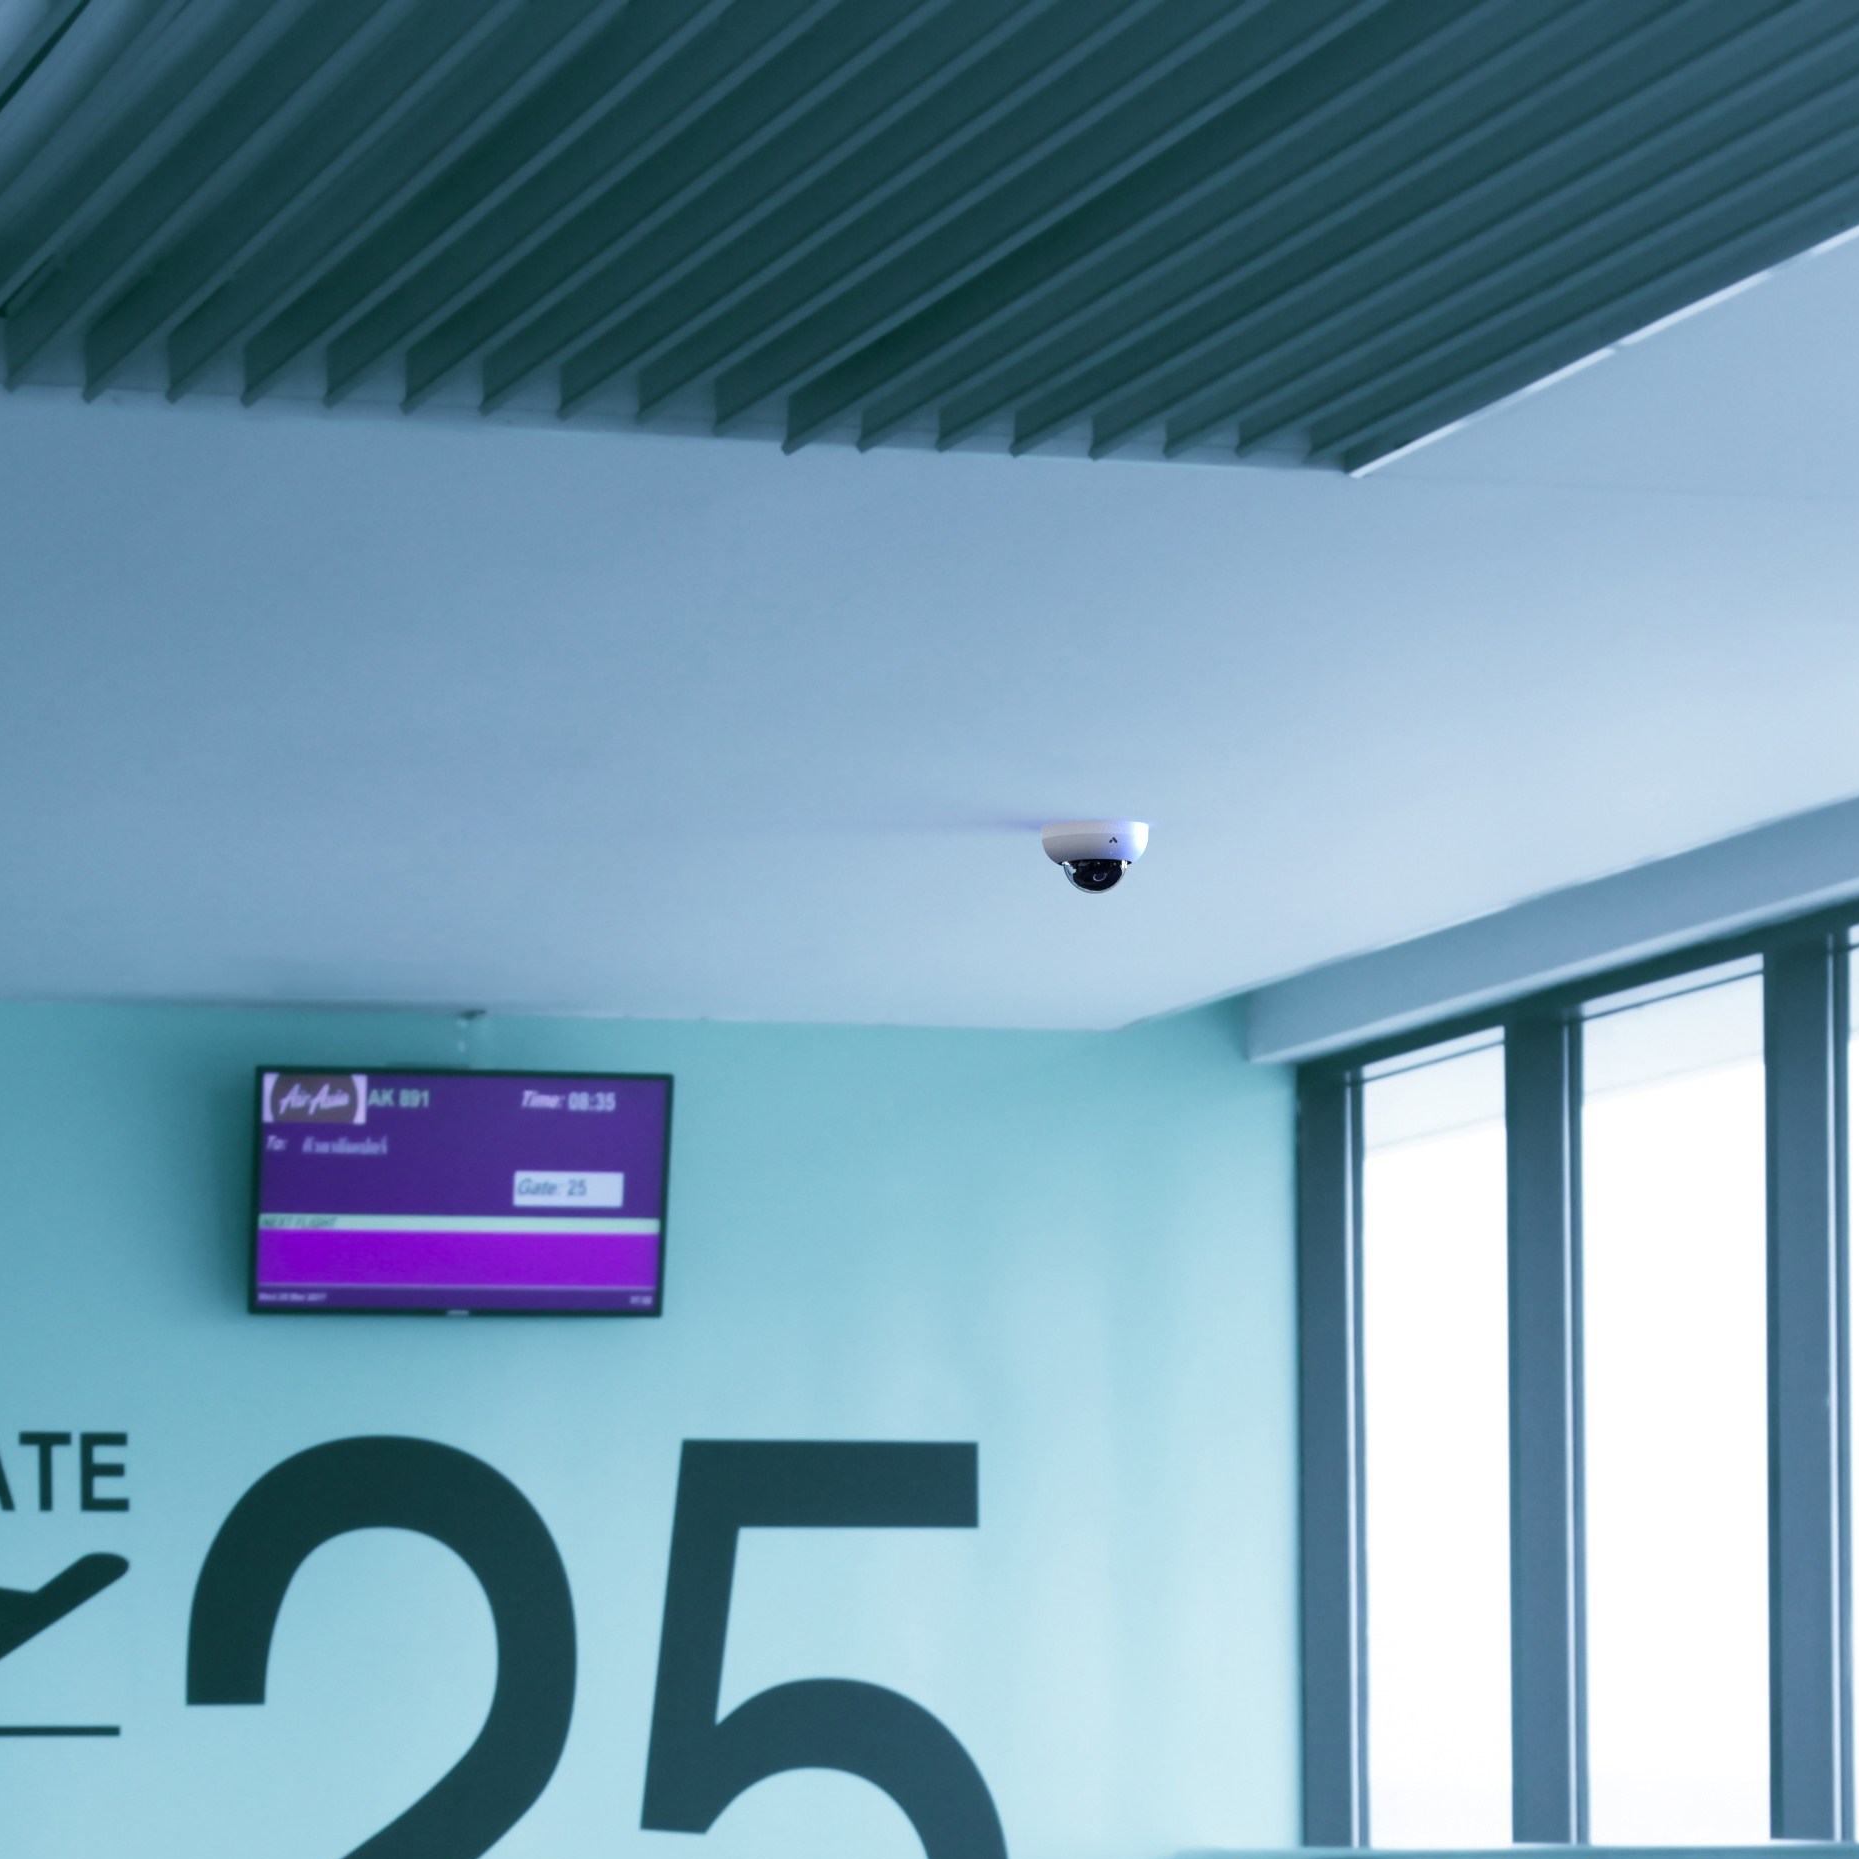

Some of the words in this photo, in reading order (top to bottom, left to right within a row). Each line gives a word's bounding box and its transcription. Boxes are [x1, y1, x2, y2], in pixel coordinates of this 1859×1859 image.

[368, 1088, 395, 1107] AK
[522, 1089, 565, 1109] Time:
[567, 1178, 587, 1196] 25
